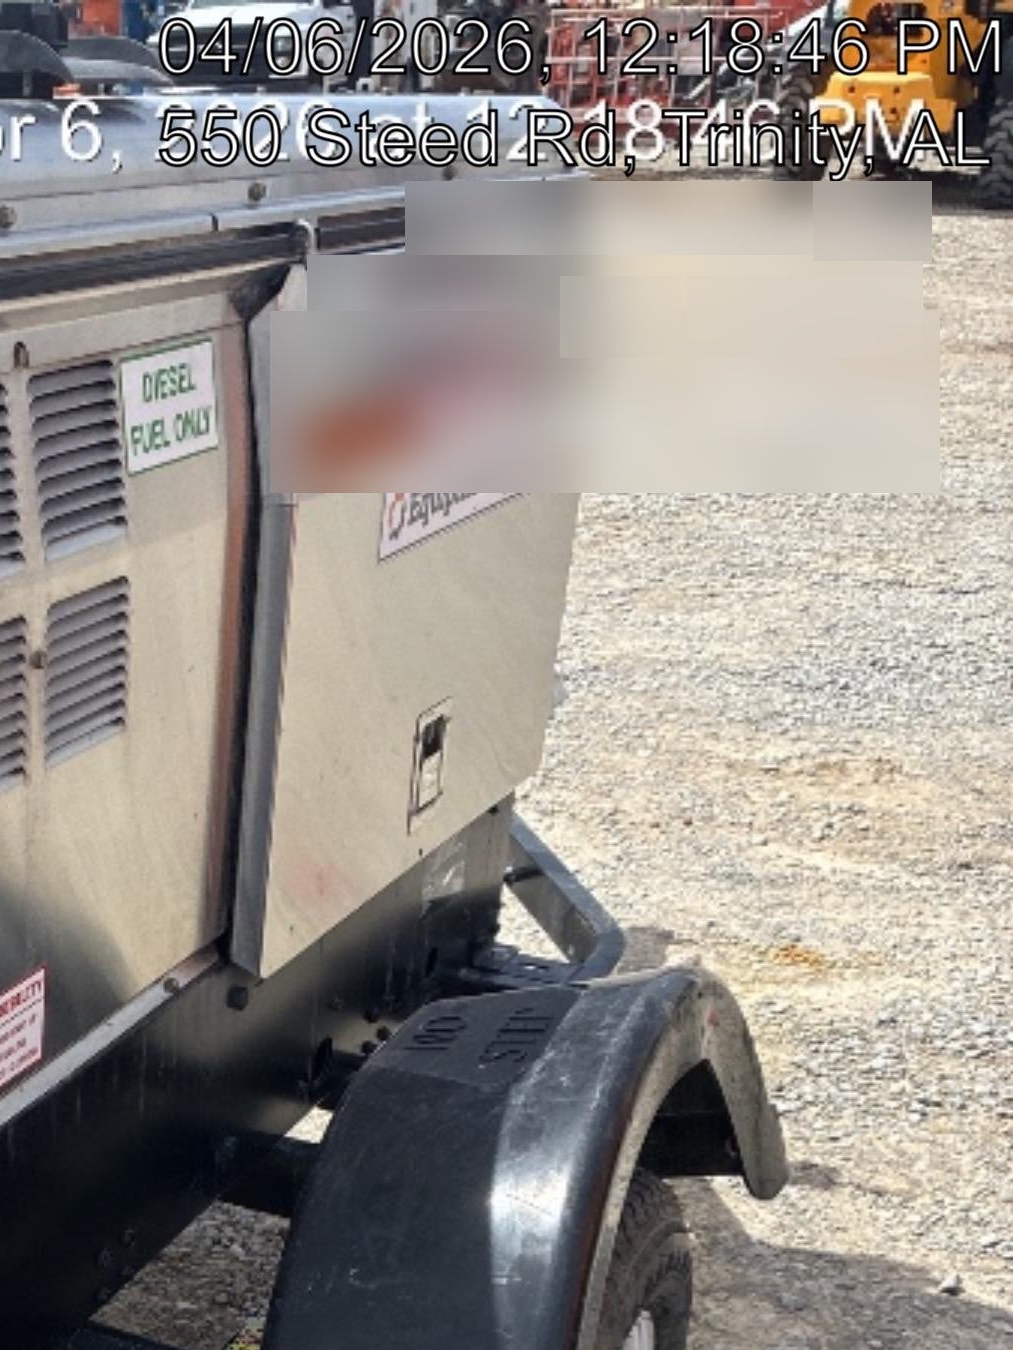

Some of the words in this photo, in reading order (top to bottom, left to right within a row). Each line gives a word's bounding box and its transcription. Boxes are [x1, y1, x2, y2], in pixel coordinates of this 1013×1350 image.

[142, 362, 197, 403] DIESEL
[130, 418, 171, 457] FUEL
[174, 405, 214, 442] ONLY
